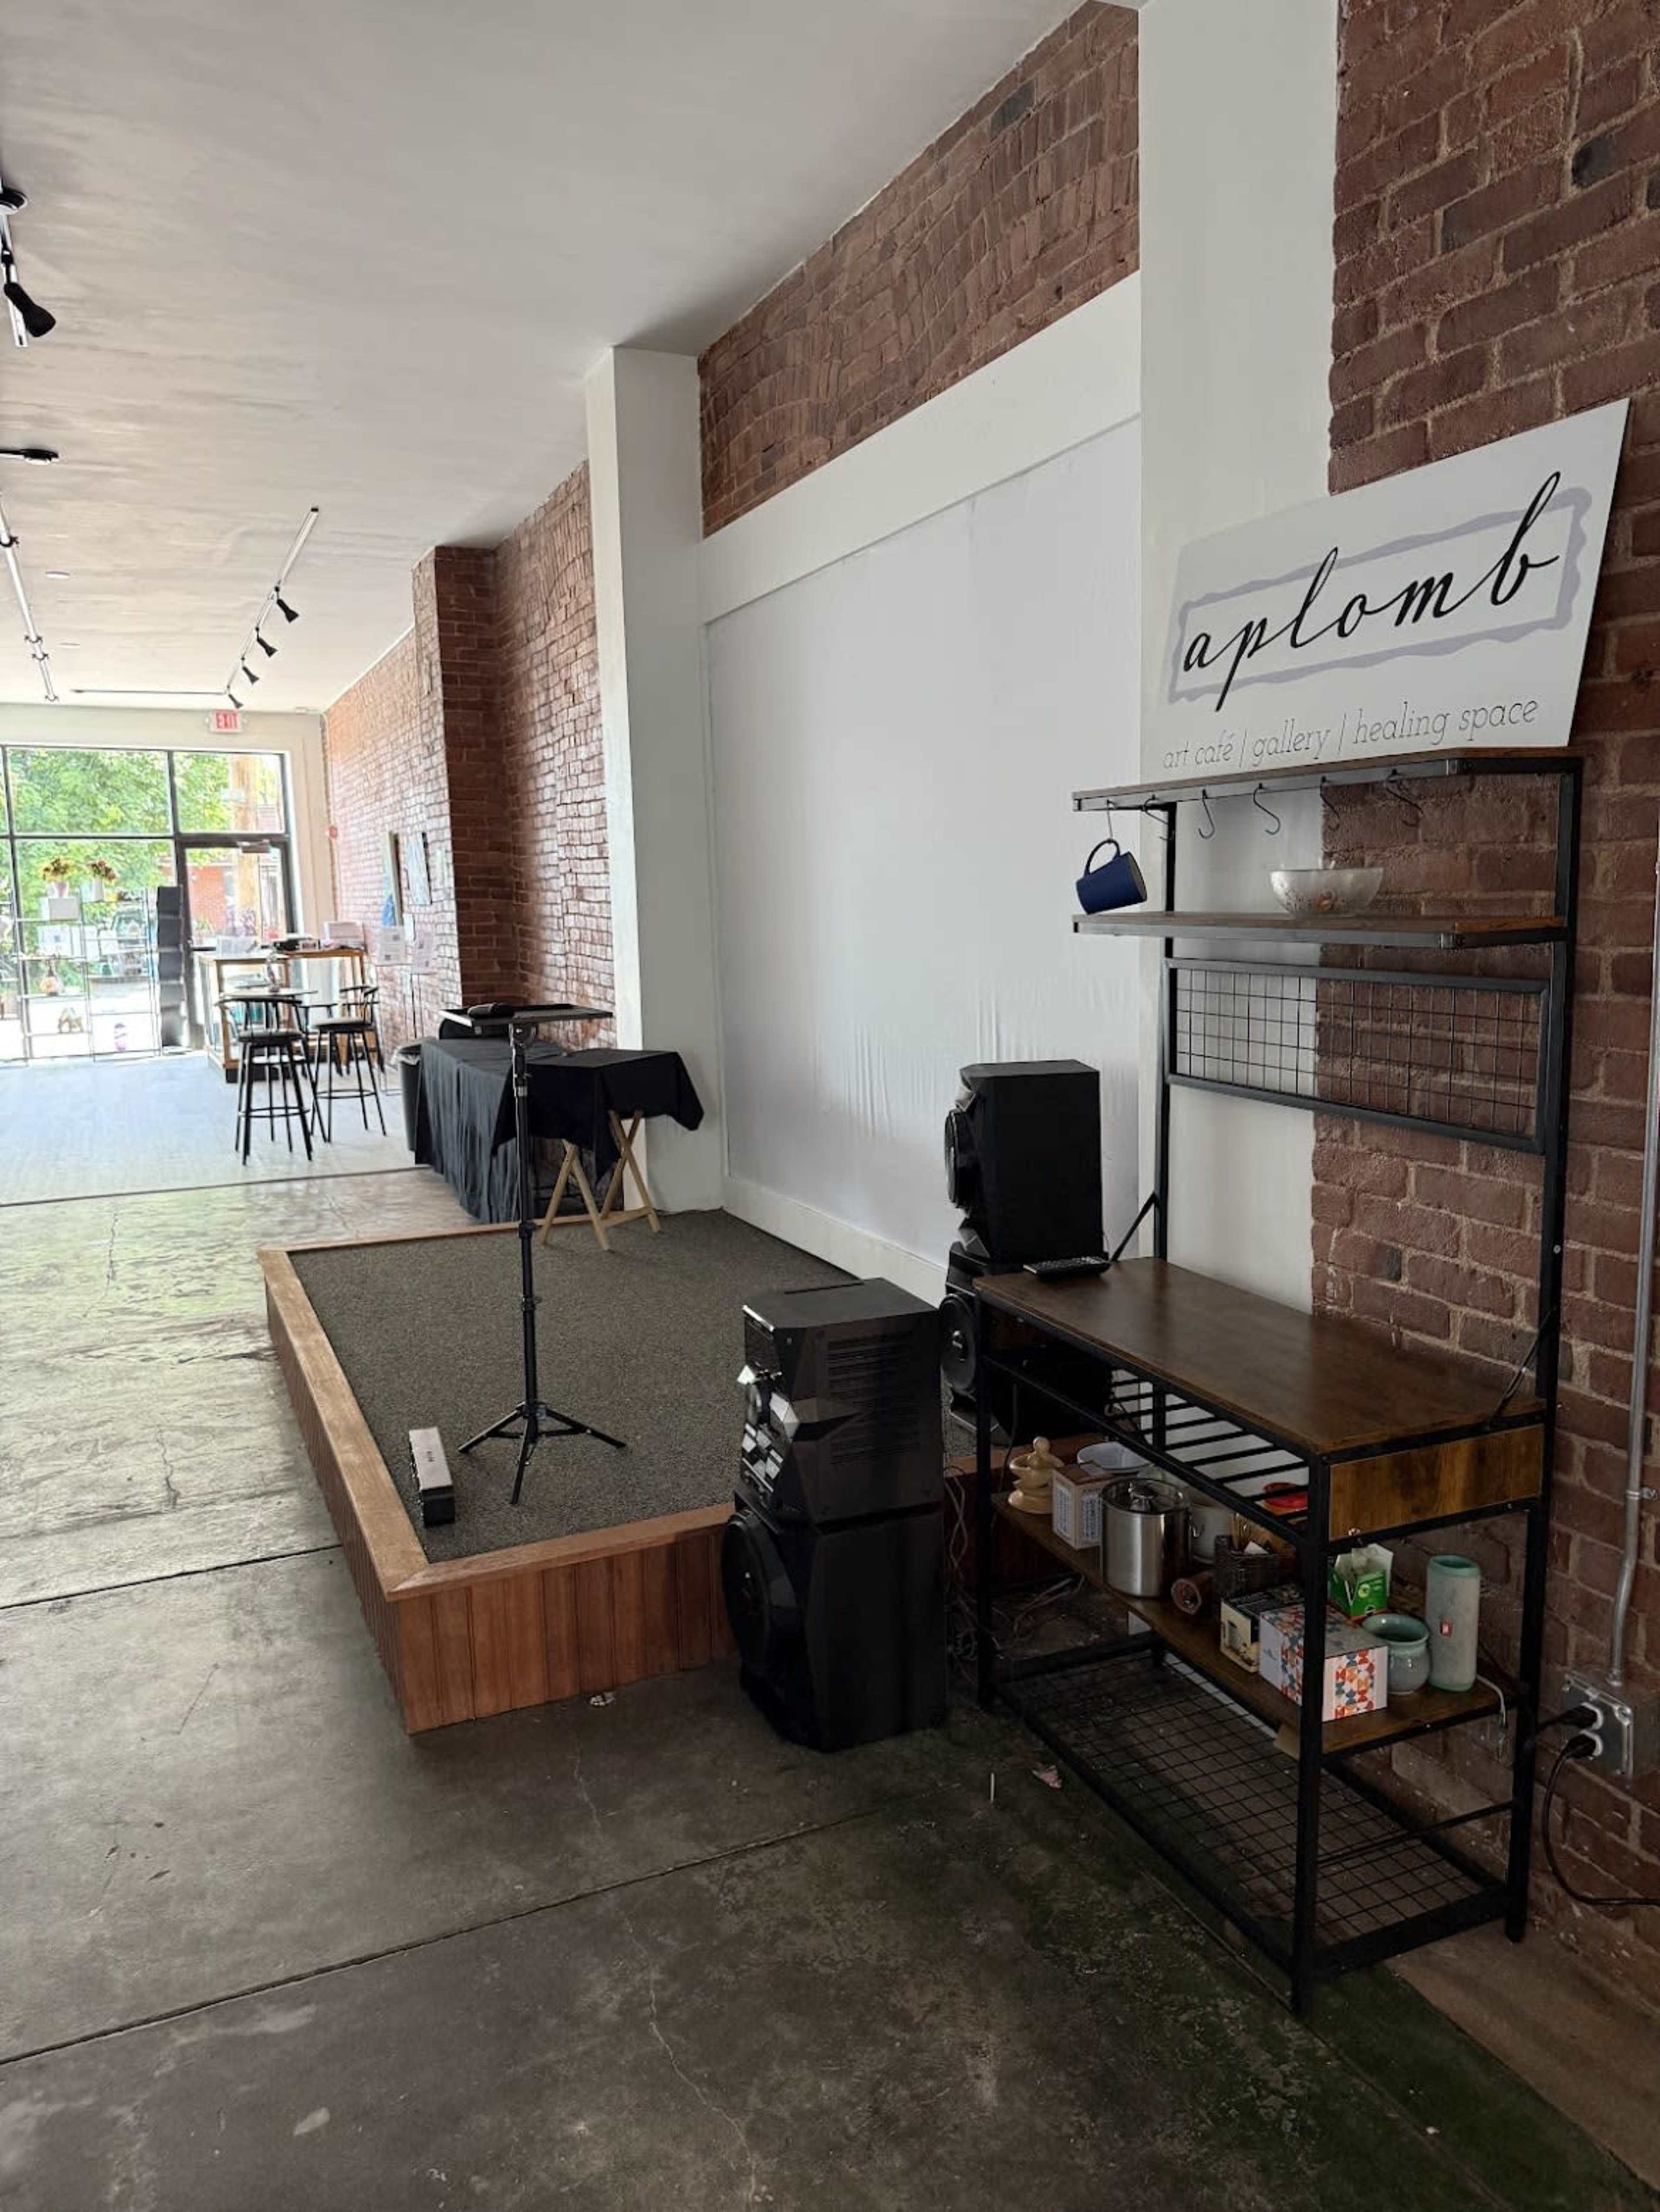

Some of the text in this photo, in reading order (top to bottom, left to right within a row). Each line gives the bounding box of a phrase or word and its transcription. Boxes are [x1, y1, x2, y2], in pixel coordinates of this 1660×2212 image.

[1183, 471, 1561, 713] aplomb
[216, 713, 238, 729] EXIT
[1162, 740, 1189, 769] art
[1194, 729, 1235, 765] café
[1251, 718, 1331, 767] gallery
[1352, 700, 1450, 745] healing
[1459, 700, 1538, 741] space
